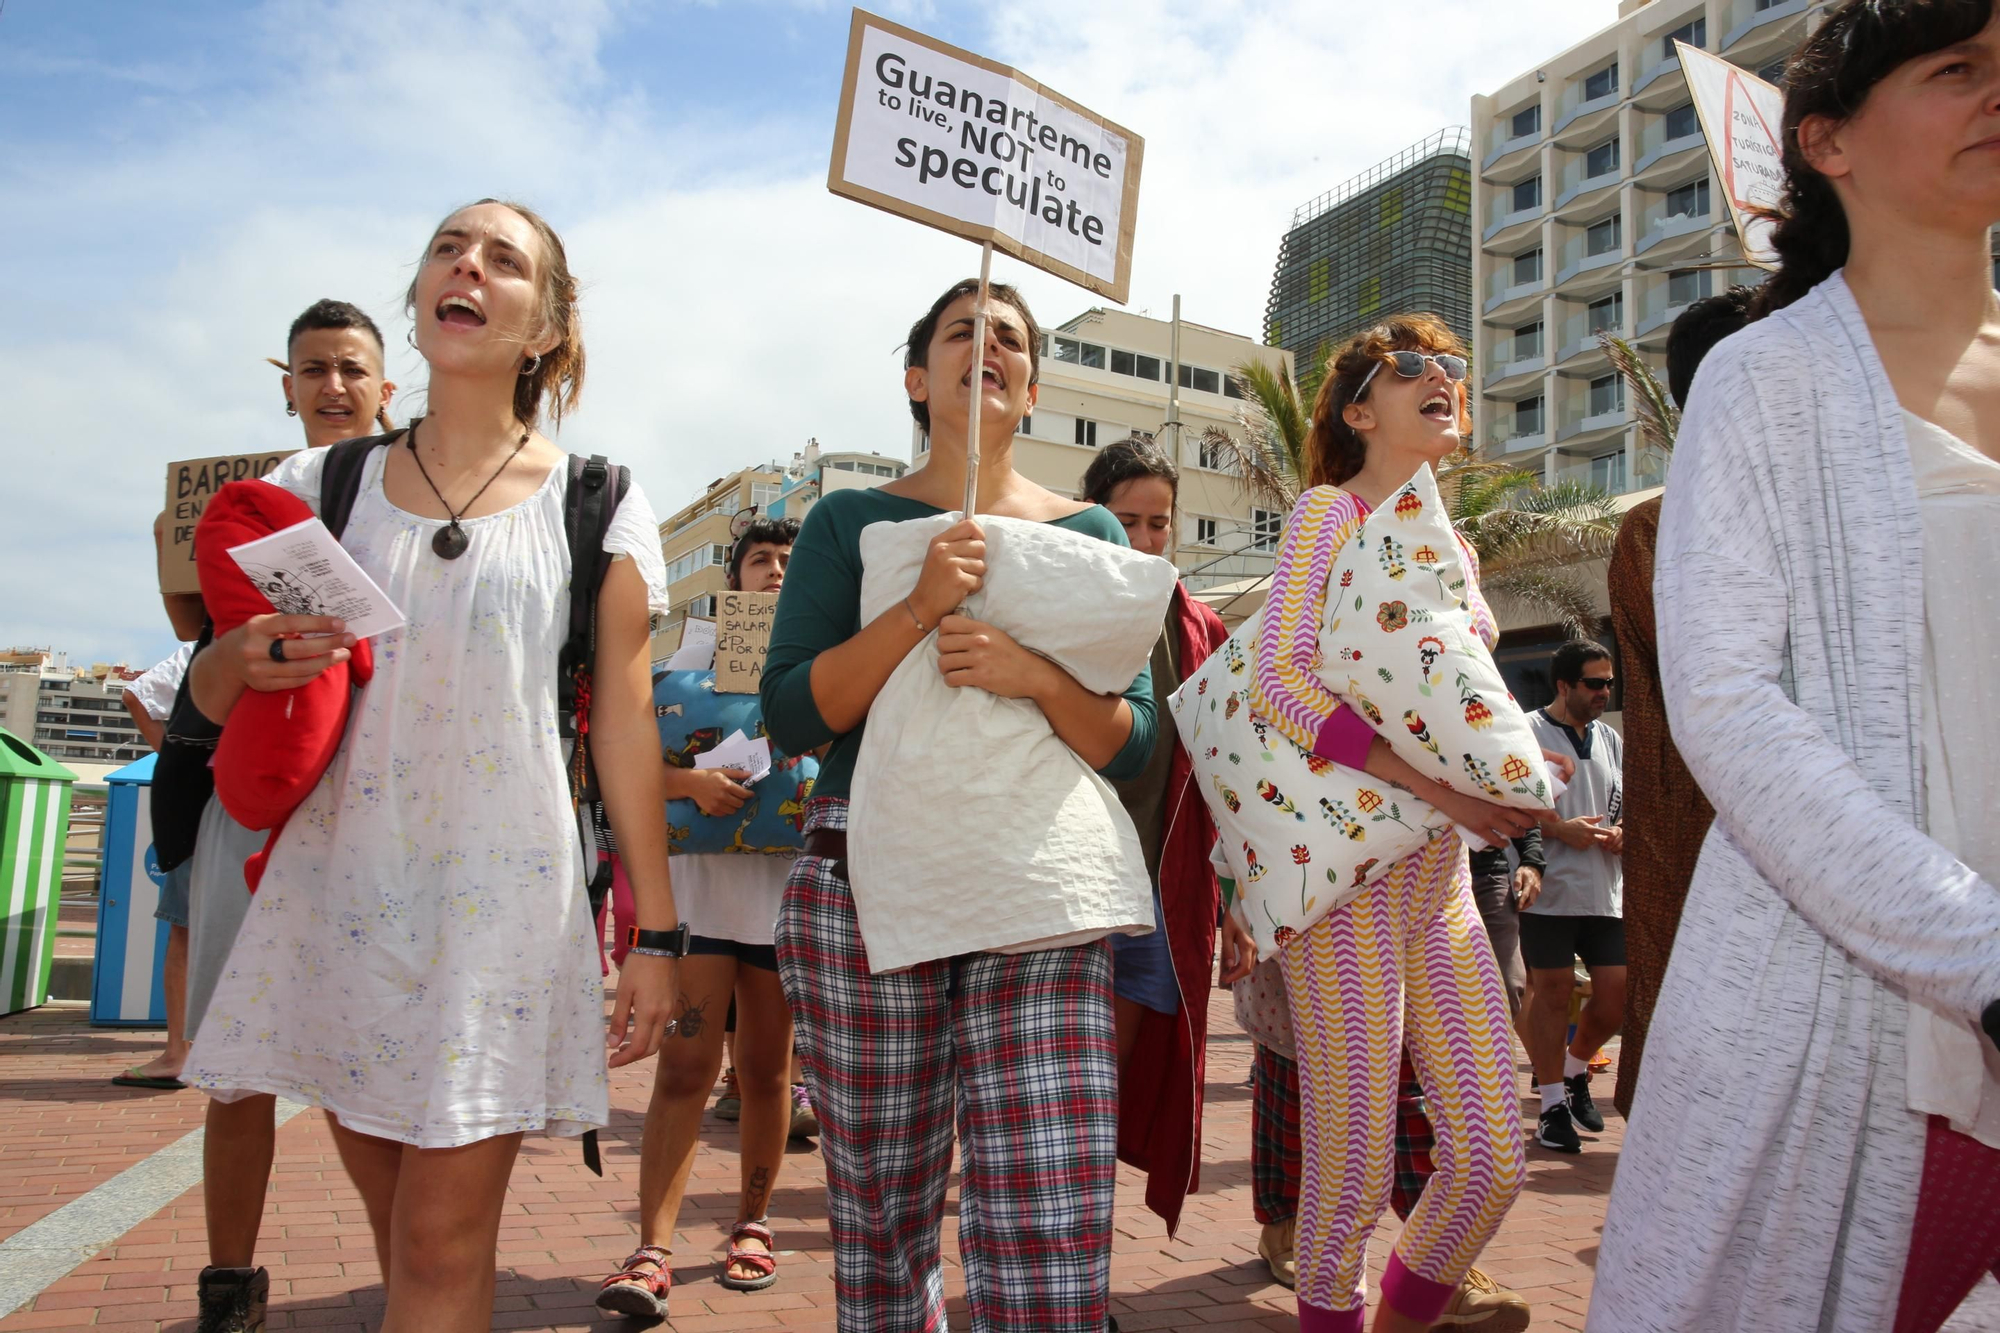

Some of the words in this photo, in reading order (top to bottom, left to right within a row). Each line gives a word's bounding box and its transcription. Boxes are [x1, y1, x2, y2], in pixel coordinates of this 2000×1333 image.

[876, 52, 1112, 178] Guanarteme
[878, 88, 901, 110] to
[909, 97, 953, 133] live,
[961, 120, 1034, 173] NOT
[1047, 169, 1066, 192] to
[1733, 110, 1762, 131] ZONA
[895, 137, 1104, 245] speculate
[725, 620, 771, 633] SALARI
[729, 659, 747, 673] EL
